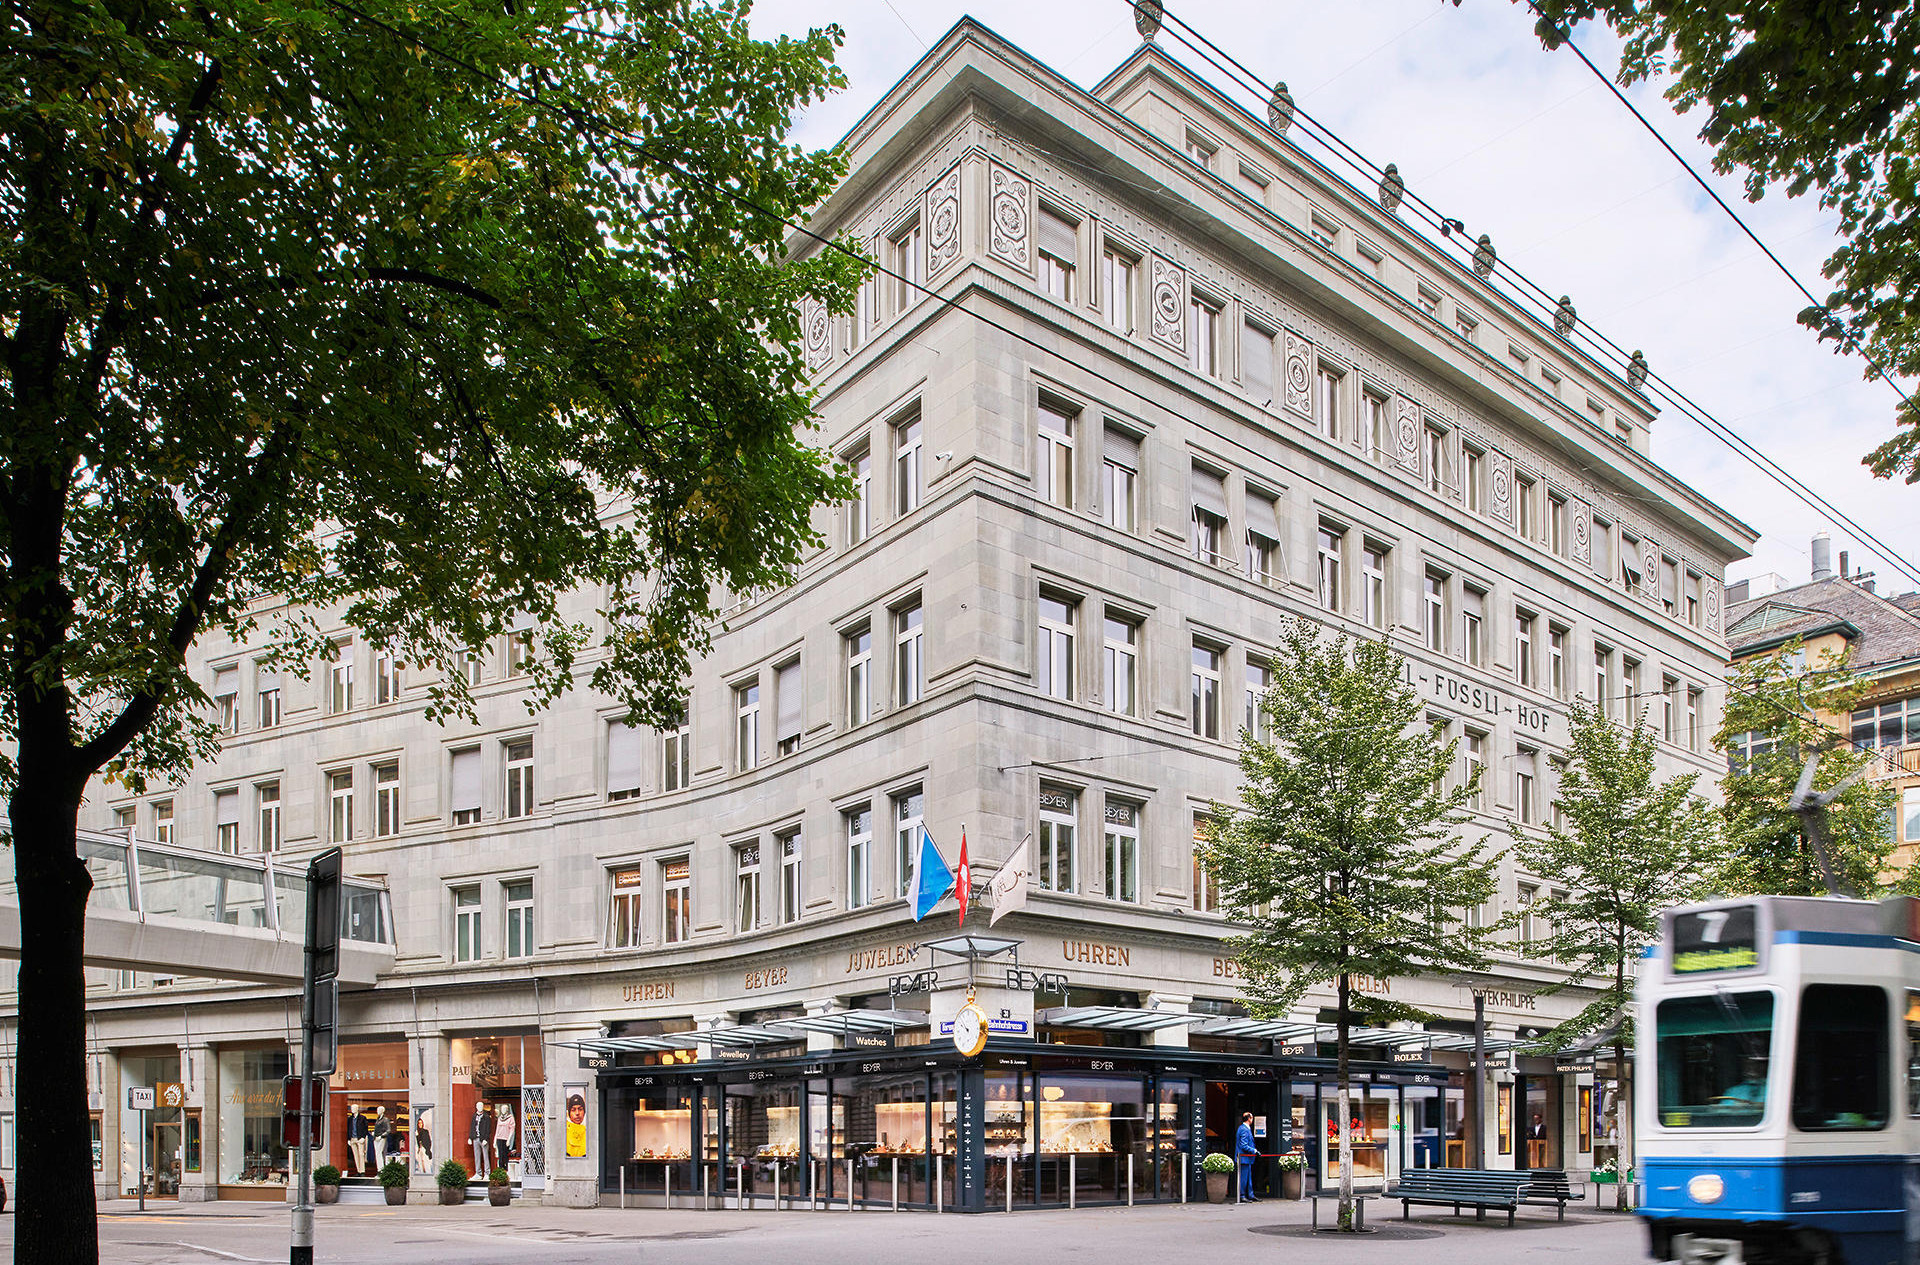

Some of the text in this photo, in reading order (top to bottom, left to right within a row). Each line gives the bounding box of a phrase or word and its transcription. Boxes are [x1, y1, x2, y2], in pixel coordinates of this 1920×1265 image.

[1696, 911, 1730, 943] 7
[845, 942, 917, 973] JUWELEN
[1062, 940, 1130, 967] UHREN
[744, 966, 788, 990] BEYER
[888, 970, 941, 997] BEYER
[1005, 968, 1071, 996] BEYER
[622, 981, 676, 1002] UHREN
[1500, 991, 1536, 1010] PHILIPPE
[855, 1036, 887, 1047] Watches
[718, 1050, 751, 1060] Jewellery
[1282, 1046, 1304, 1055] BEYER
[588, 1059, 608, 1067] BEYER
[1394, 1053, 1423, 1062] ROLEX
[863, 1062, 881, 1073] BEYER
[1091, 1061, 1114, 1070] BEYER
[1236, 1066, 1256, 1076] BEYER
[337, 1069, 396, 1080] FRATELLI
[1414, 1074, 1430, 1083] BEYER
[634, 1077, 654, 1085] BEYER
[135, 1091, 152, 1101] TAXI
